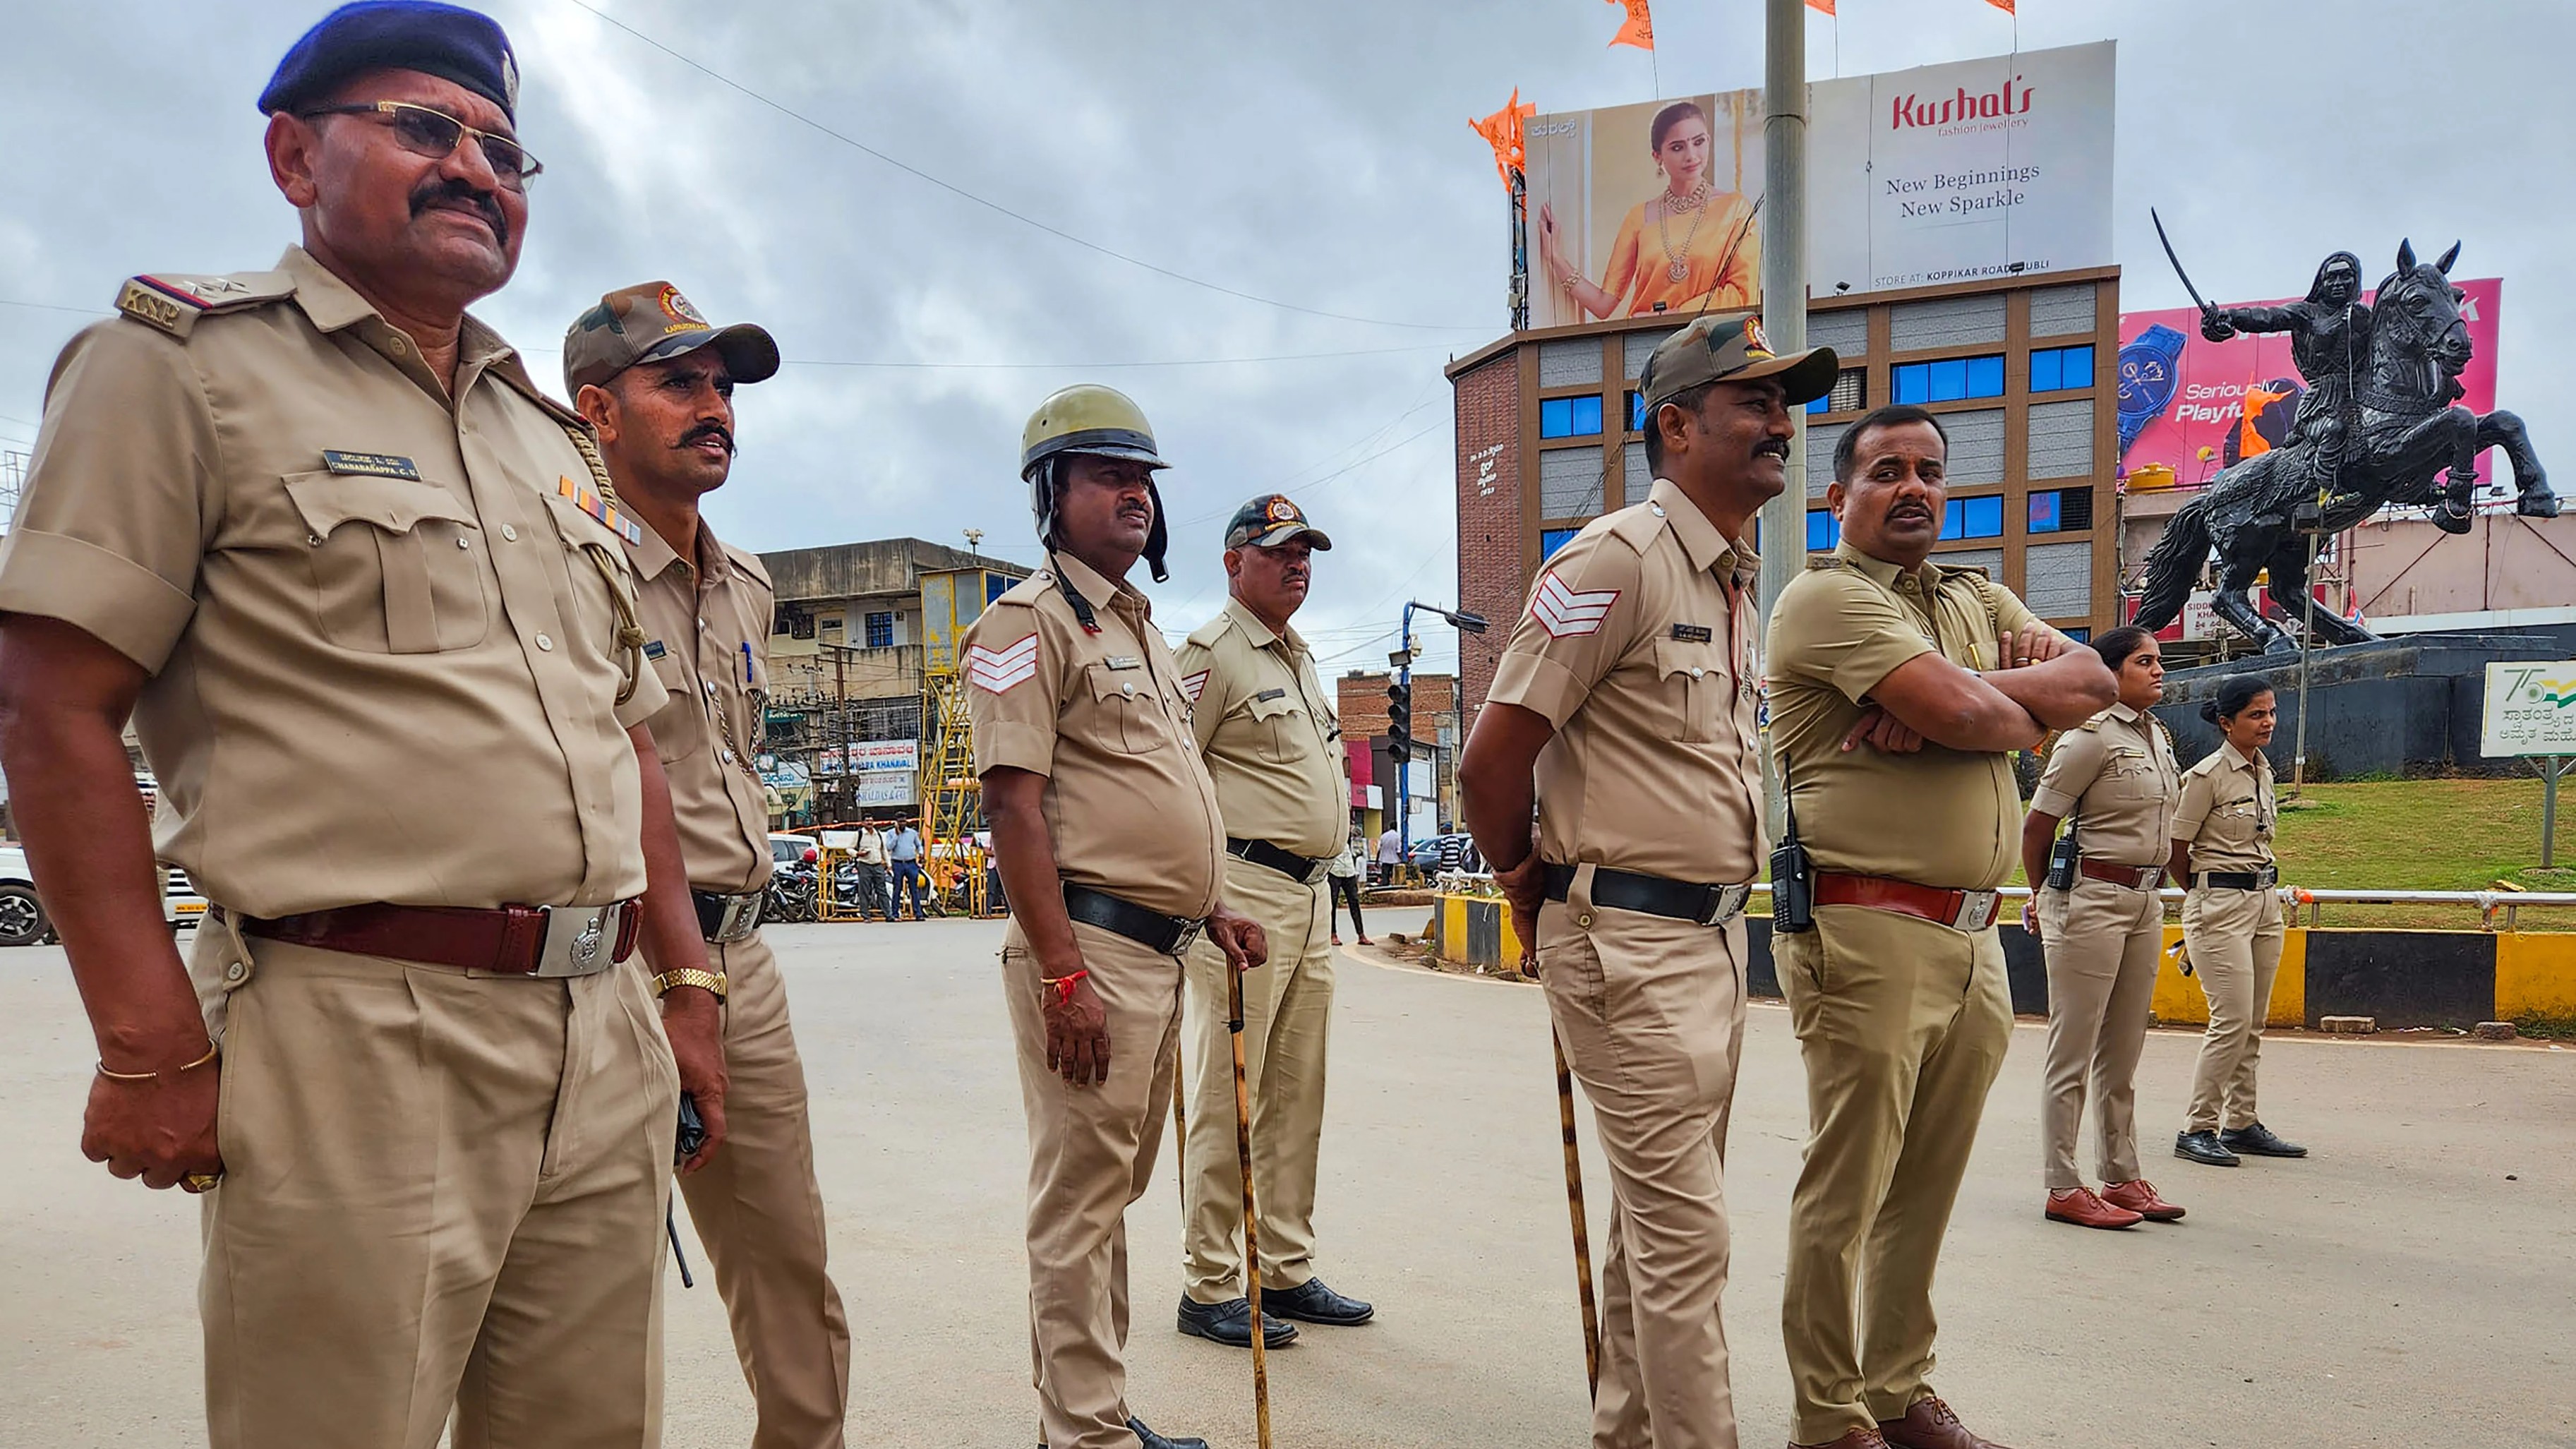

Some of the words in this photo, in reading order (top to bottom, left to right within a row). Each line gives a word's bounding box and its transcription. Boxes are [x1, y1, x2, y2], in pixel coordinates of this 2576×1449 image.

[1892, 74, 2035, 130] Kushal's
[1938, 124, 1977, 137] fashion
[1980, 119, 2029, 133] jewellery
[1886, 179, 1927, 195] New
[1934, 165, 2040, 190] Beginnings
[1901, 202, 1943, 218] New
[1949, 189, 2026, 215] Sparkle
[1874, 275, 1906, 287] STORE
[1909, 273, 1925, 284] AT:
[1927, 267, 1978, 281] KOPPIKAR
[2024, 260, 2050, 271] UBLI
[119, 287, 181, 327] KSP
[2184, 378, 2280, 400] Seriouly
[2174, 402, 2245, 424] Playfu
